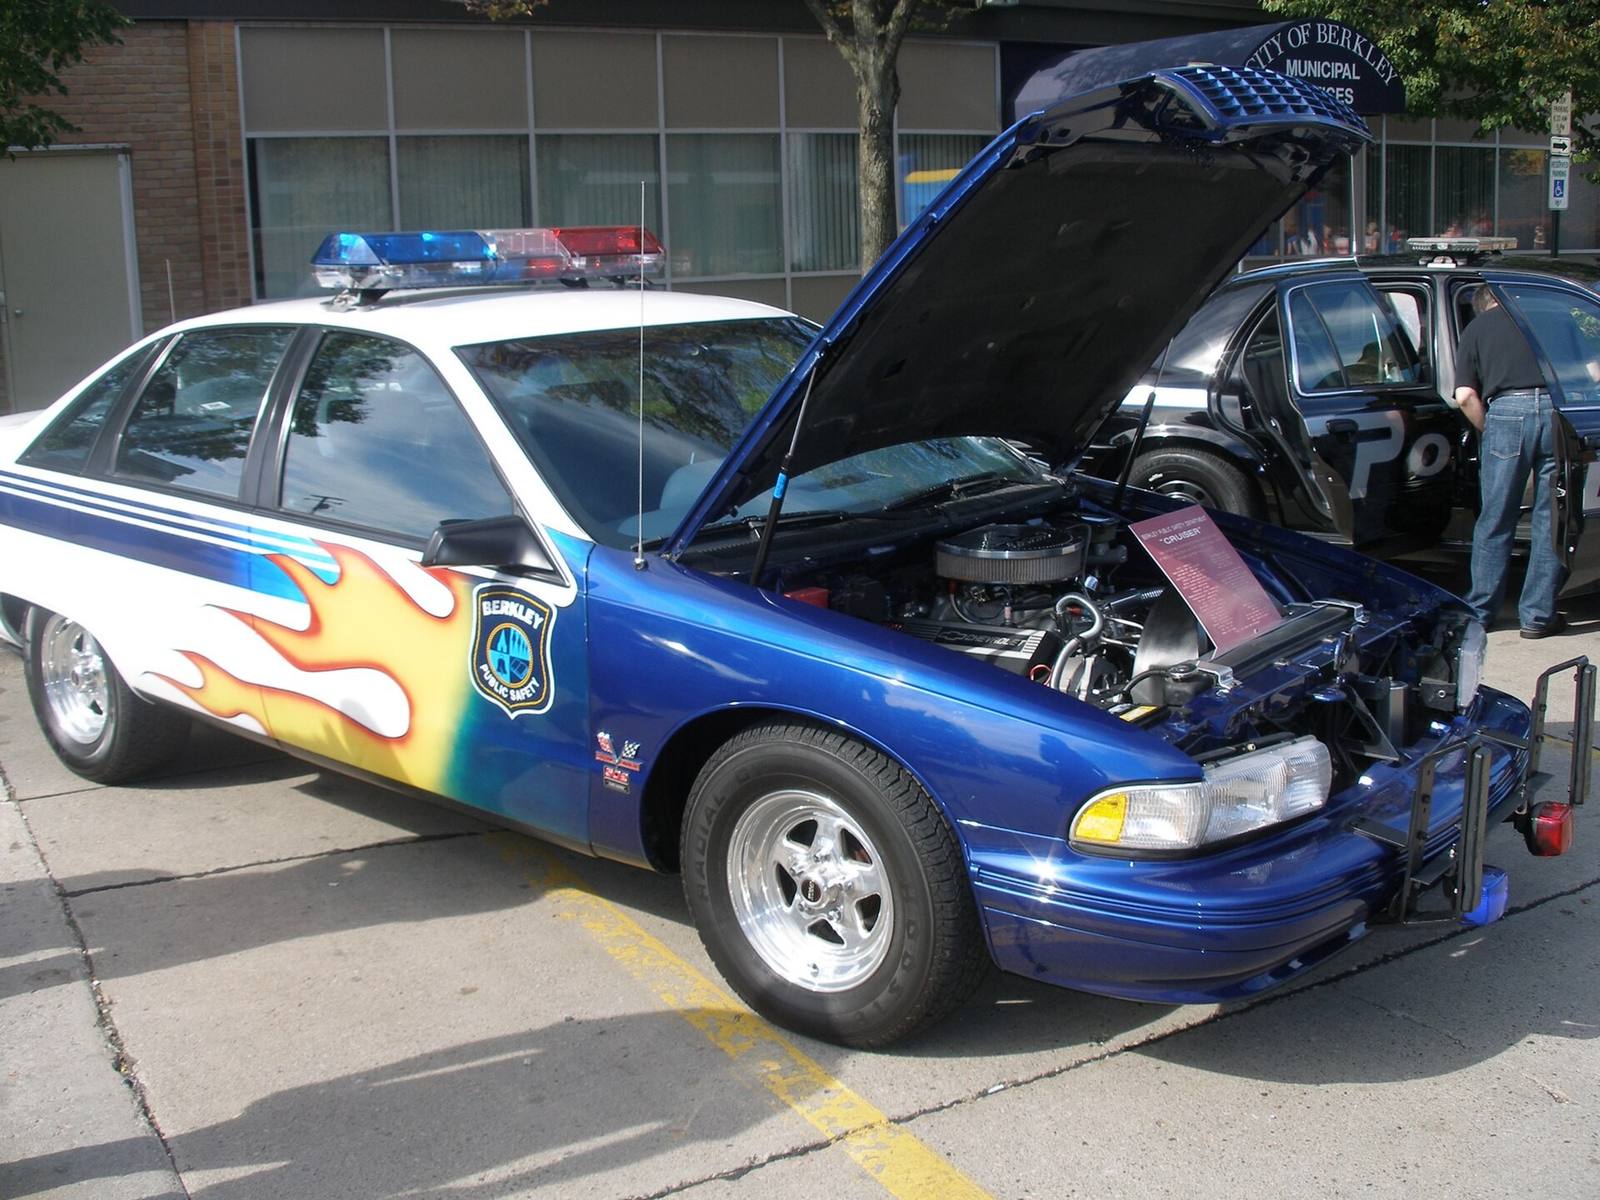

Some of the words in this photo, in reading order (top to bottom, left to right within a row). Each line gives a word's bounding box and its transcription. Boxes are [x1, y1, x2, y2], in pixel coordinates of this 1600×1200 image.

[1286, 59, 1360, 80] MUNICIPAL
[1288, 23, 1312, 48] OF
[1316, 23, 1398, 86] BERKLEY
[482, 600, 544, 629] BERKLEY
[480, 663, 509, 698] PUBLIC
[509, 677, 540, 701] SAFETY
